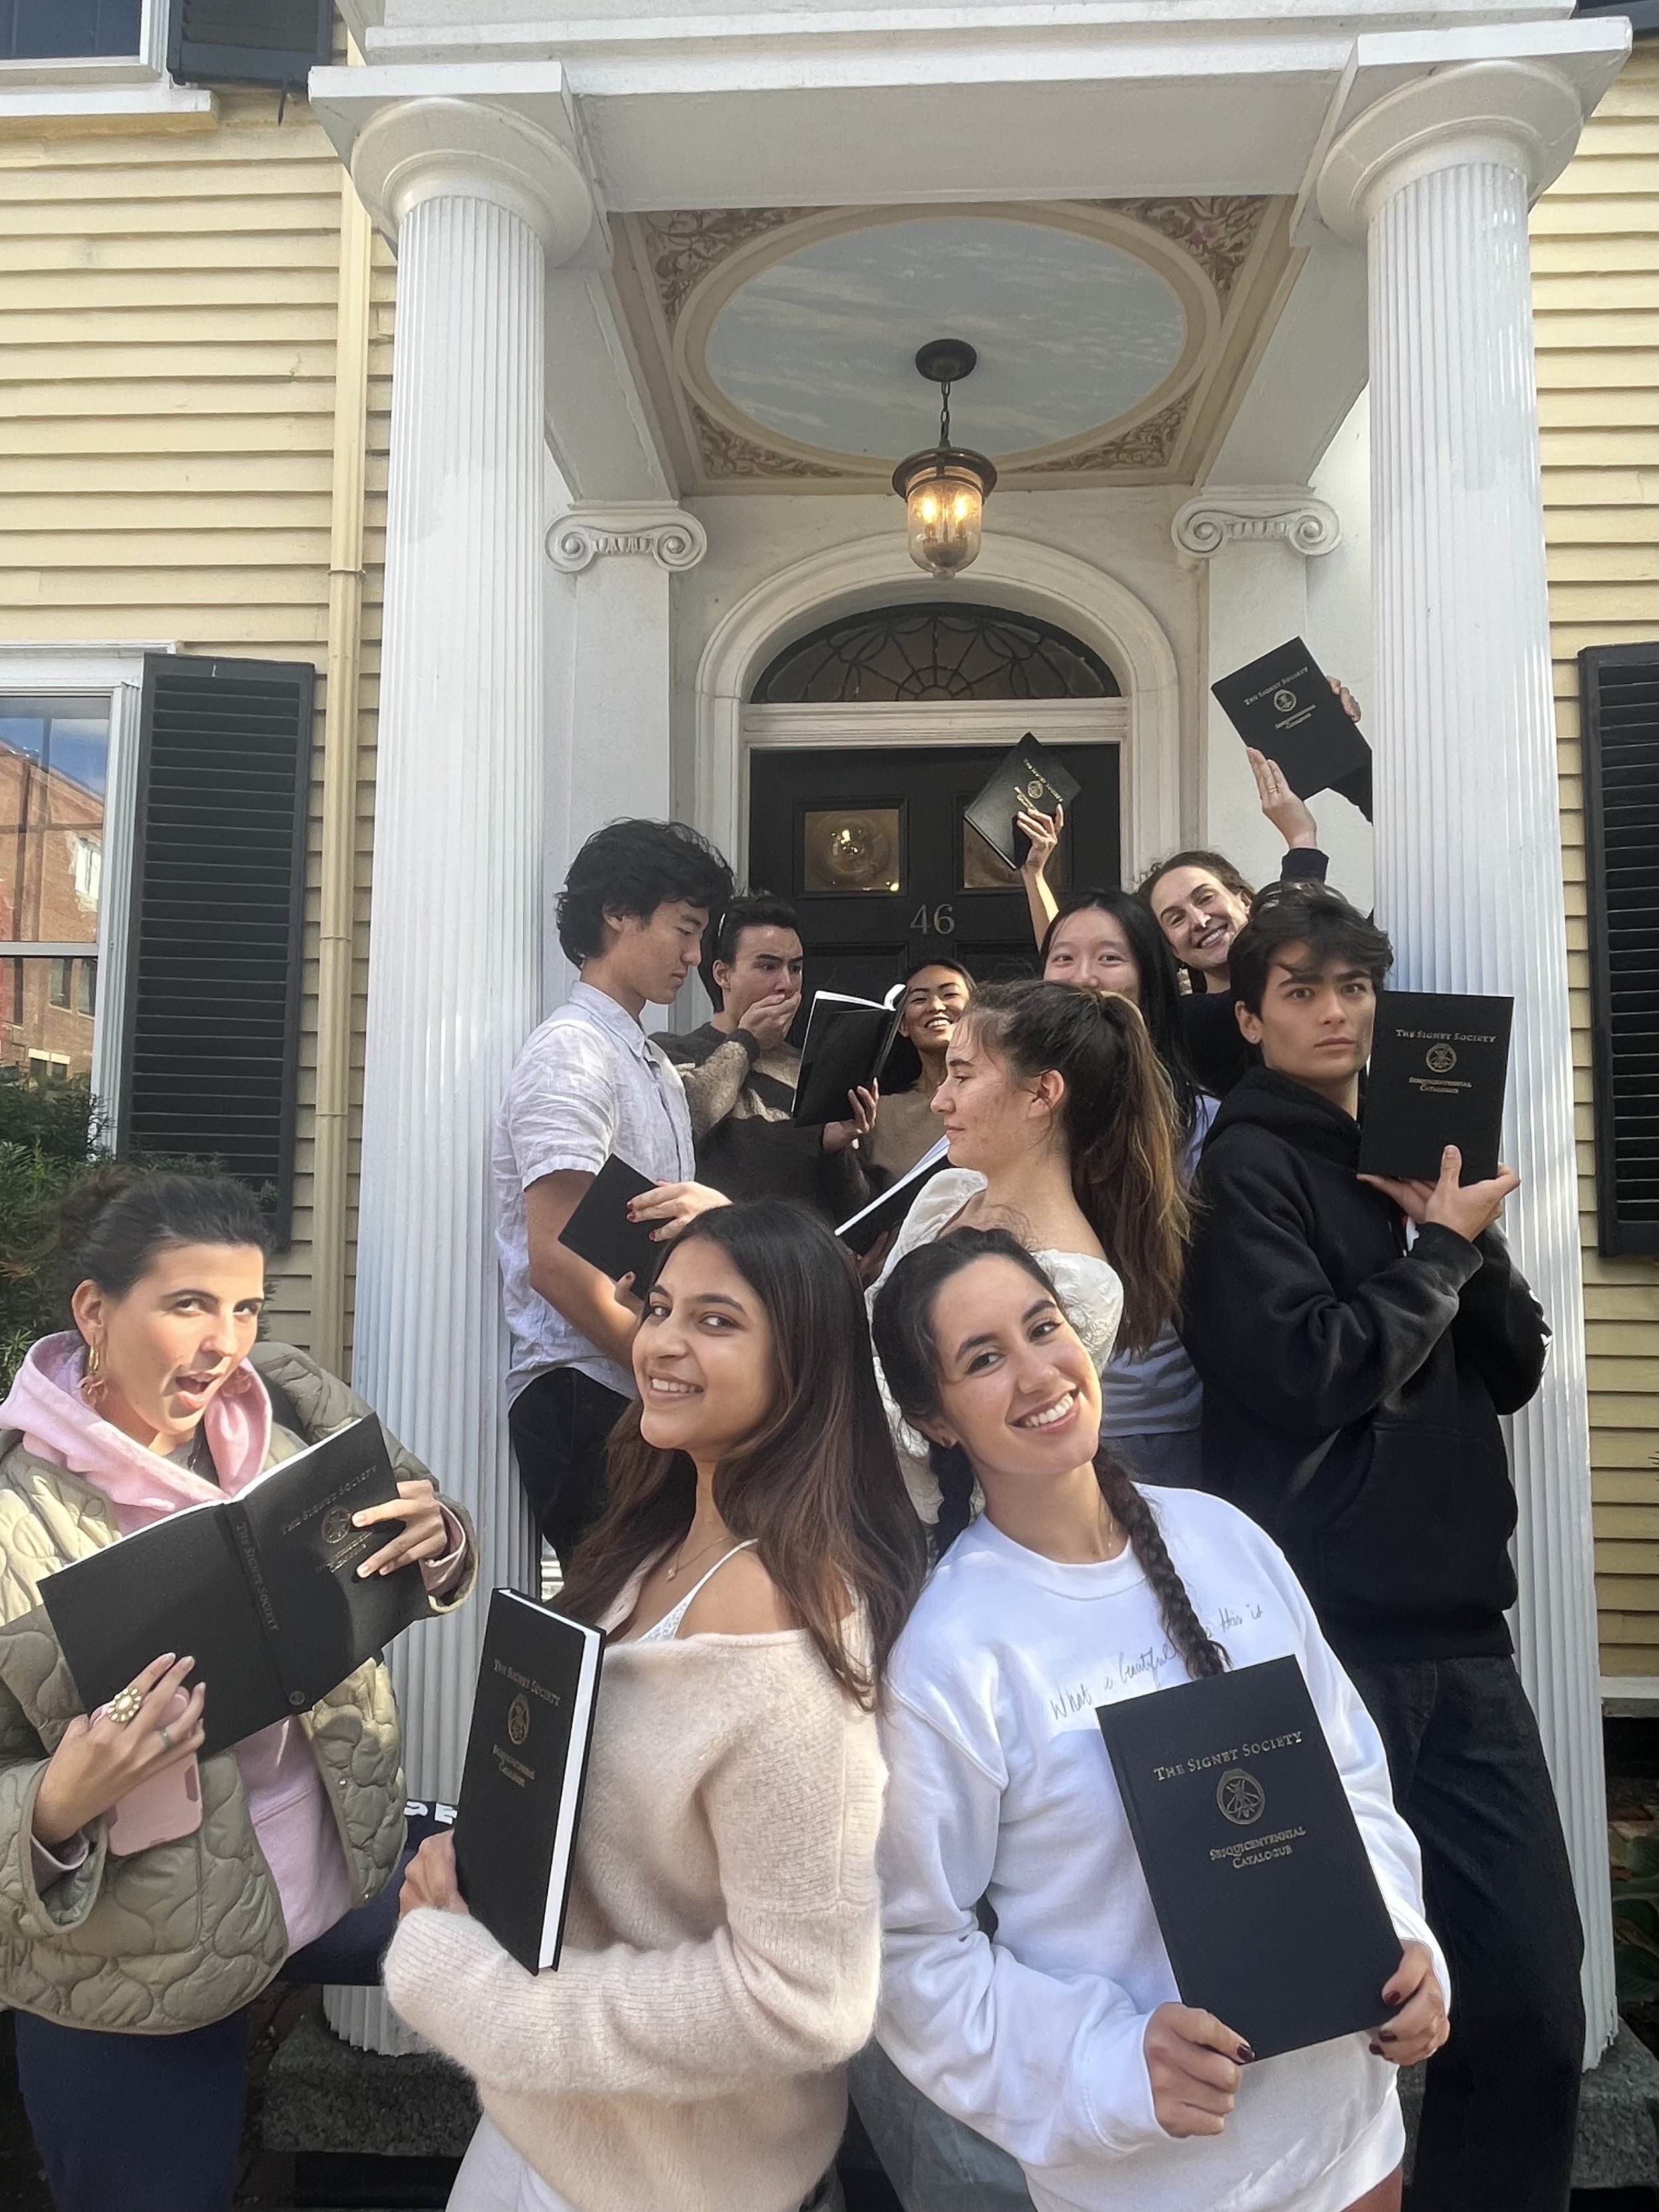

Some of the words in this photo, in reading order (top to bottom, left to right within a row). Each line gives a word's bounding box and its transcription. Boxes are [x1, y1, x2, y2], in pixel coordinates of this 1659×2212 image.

[908, 904, 955, 934] 46
[1453, 1032, 1496, 1043] SOCIETY
[1153, 1765, 1186, 1781] THE
[1187, 1748, 1239, 1773] SIGNET
[1242, 1731, 1303, 1757] SOCIETY
[1232, 1844, 1293, 1870] CATALOGUE
